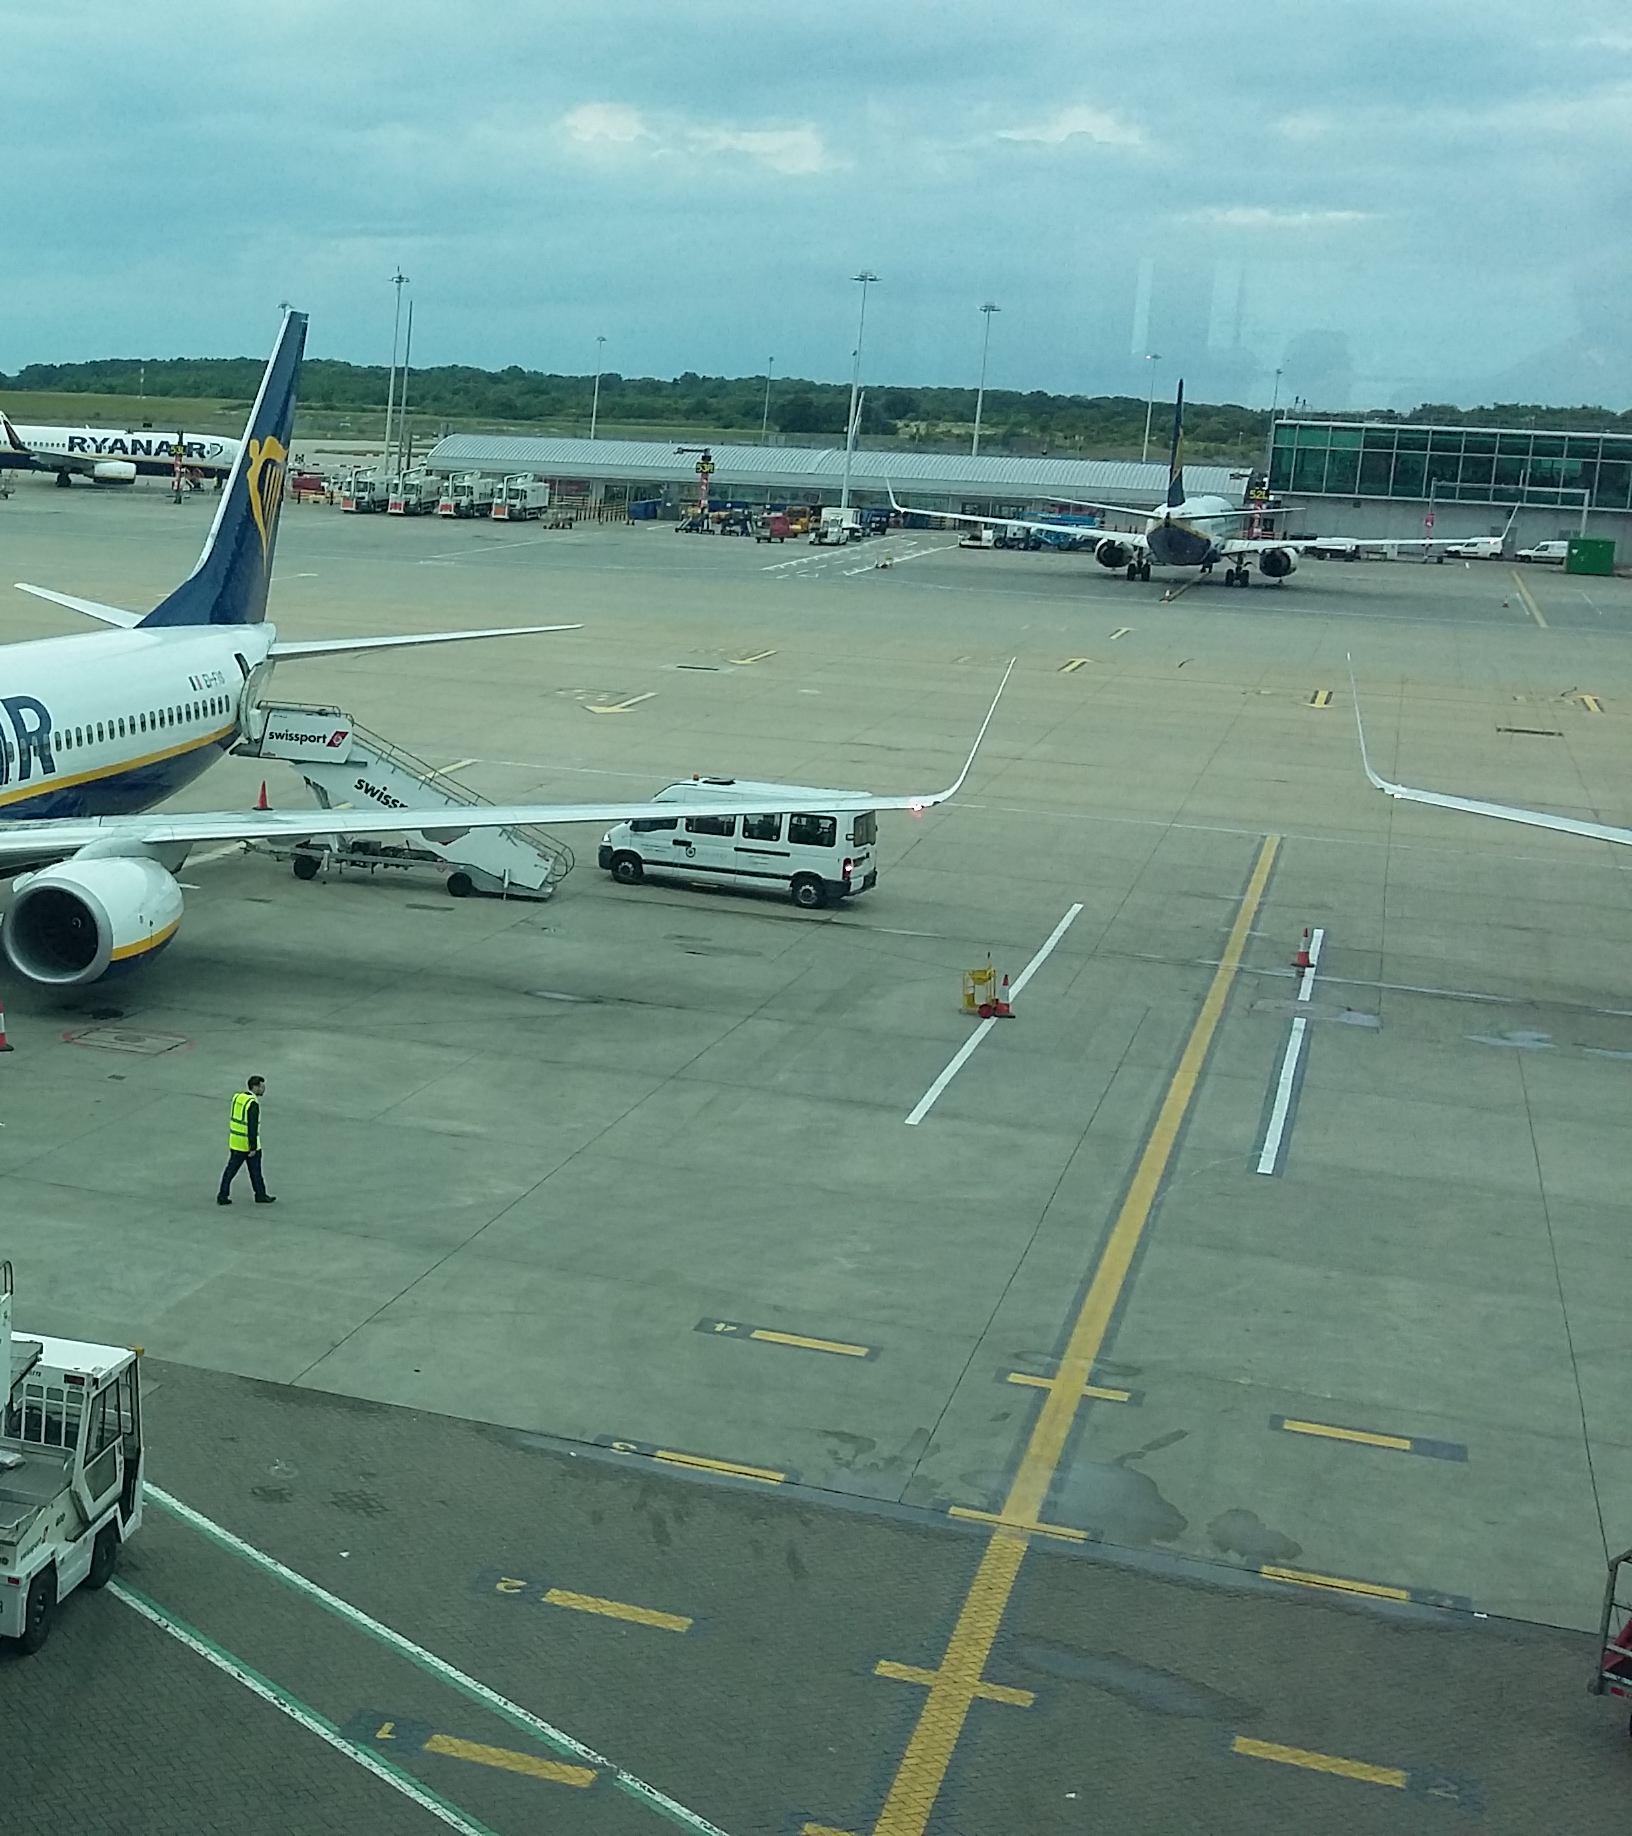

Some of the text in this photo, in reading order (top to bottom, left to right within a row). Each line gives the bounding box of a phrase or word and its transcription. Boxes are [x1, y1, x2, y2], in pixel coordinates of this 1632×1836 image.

[68, 436, 205, 459] RYANAR
[1249, 490, 1269, 500] 52L
[268, 729, 328, 745] swissport
